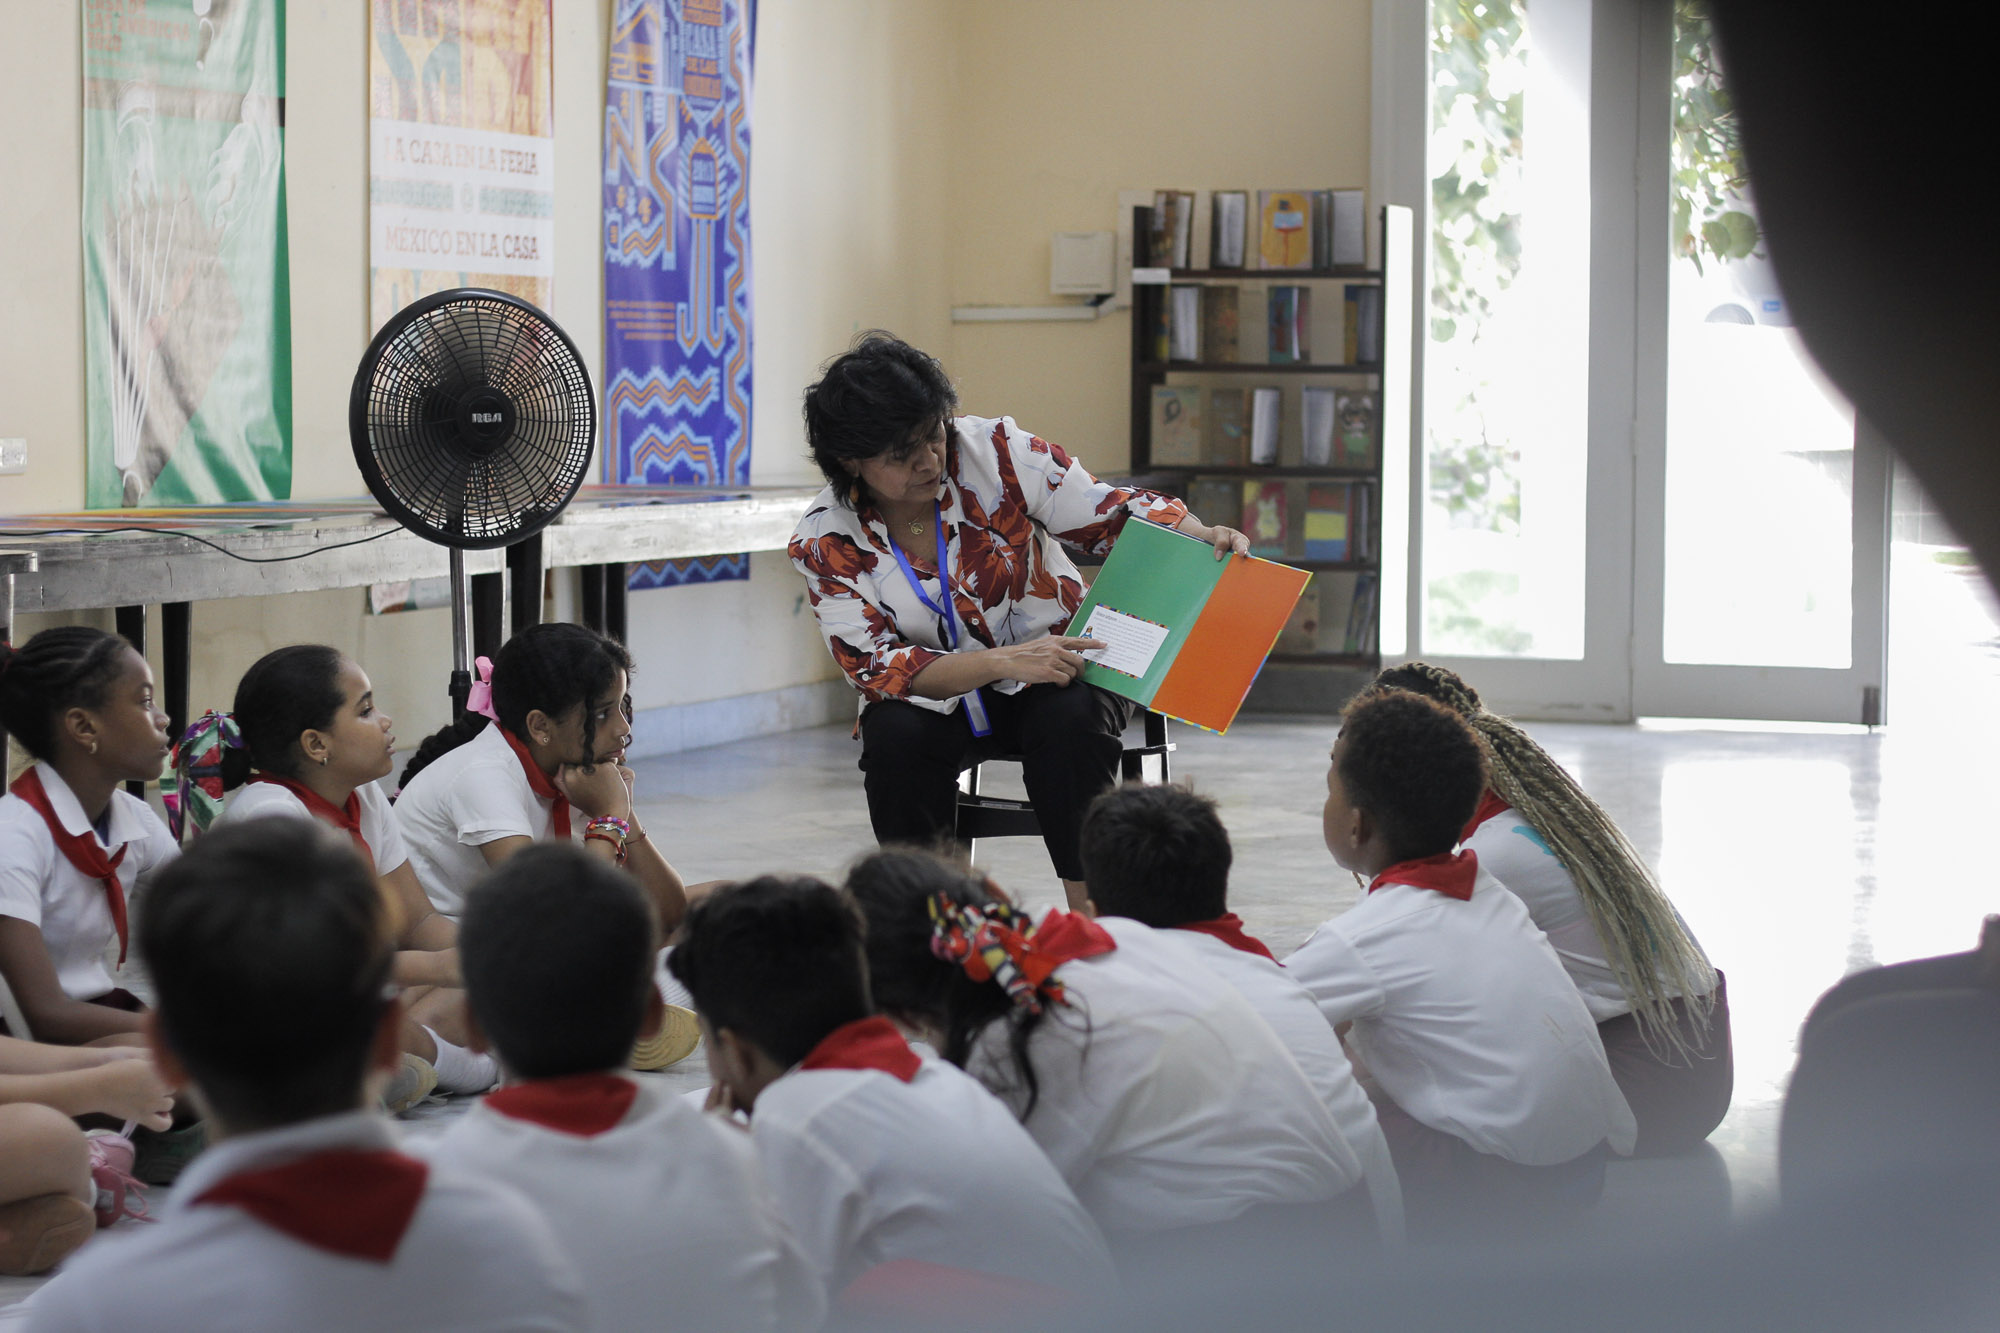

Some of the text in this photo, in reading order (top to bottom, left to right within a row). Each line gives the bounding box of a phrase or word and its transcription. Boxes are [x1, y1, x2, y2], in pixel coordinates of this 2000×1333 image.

[384, 136, 539, 175] LA CASA EN LA FERIA
[385, 217, 540, 260] MÉXICO EN LA CASA
[472, 412, 502, 423] RCA
